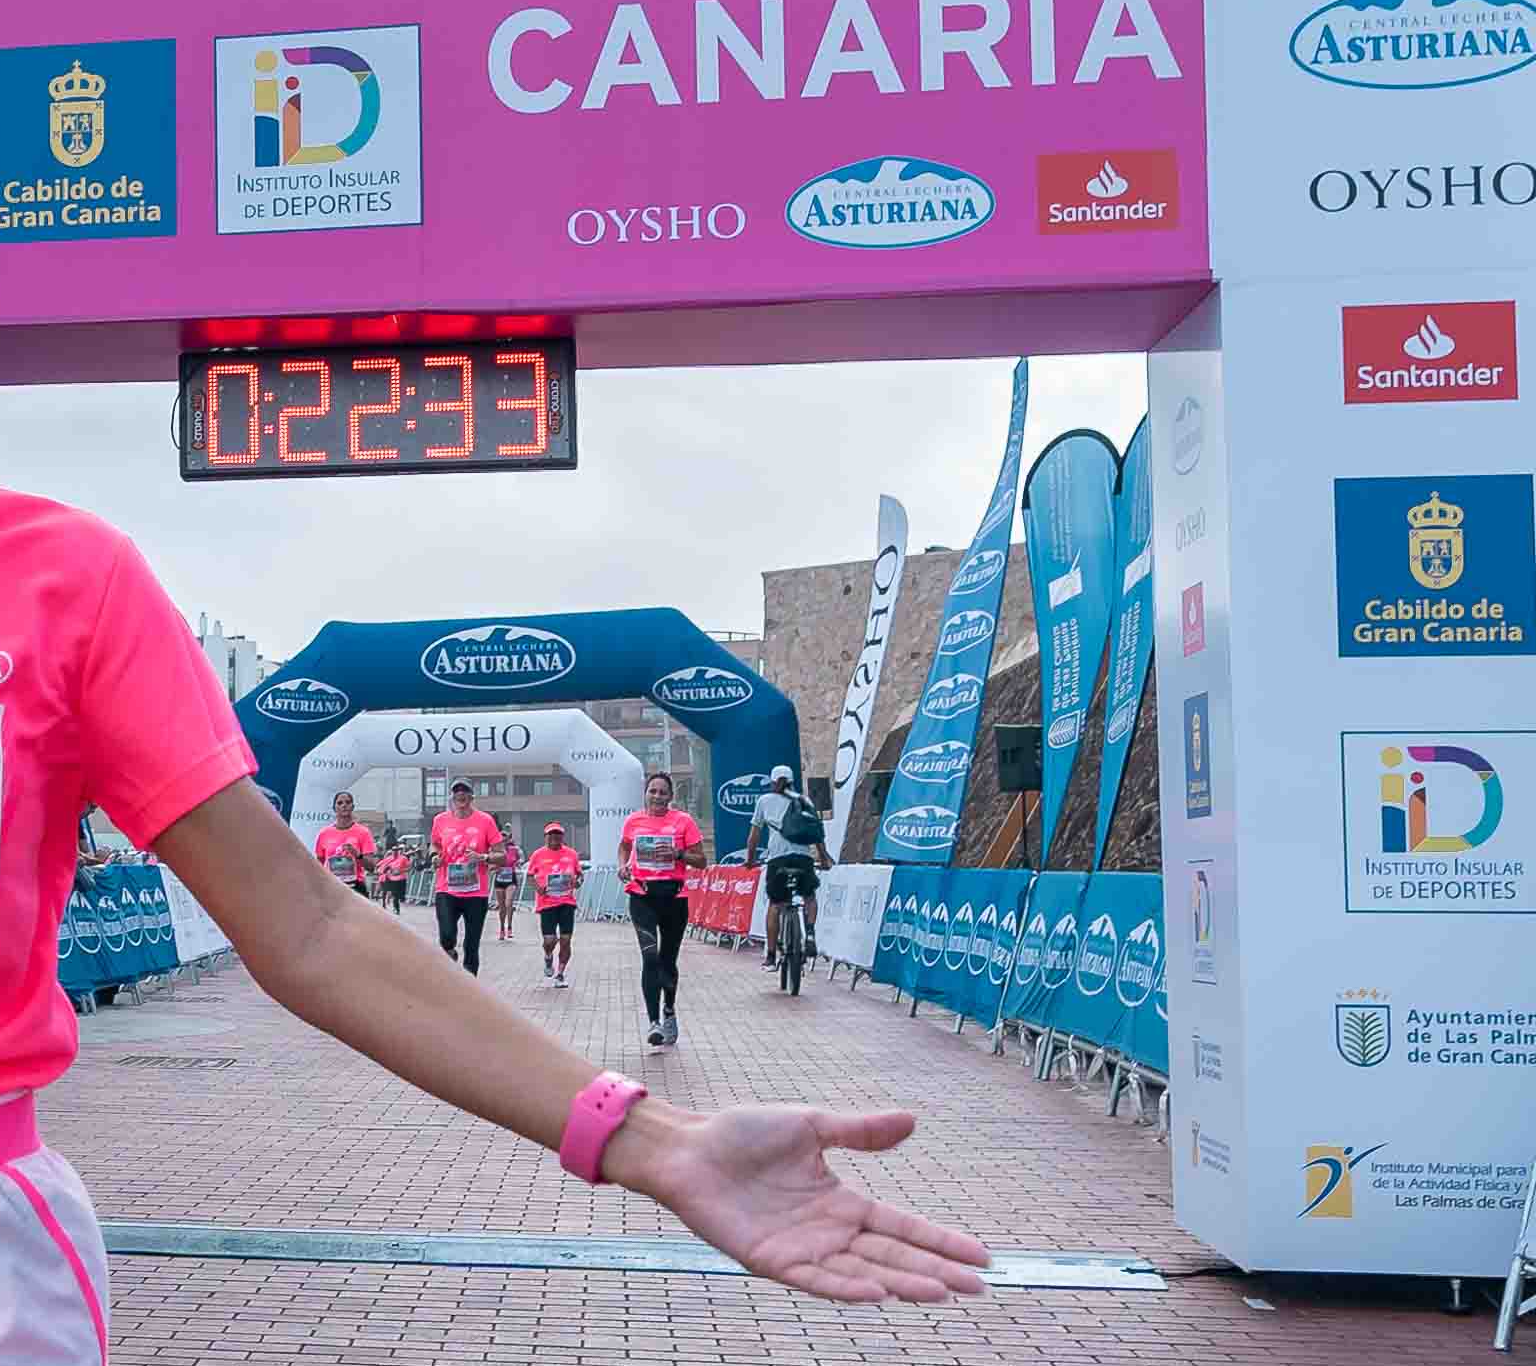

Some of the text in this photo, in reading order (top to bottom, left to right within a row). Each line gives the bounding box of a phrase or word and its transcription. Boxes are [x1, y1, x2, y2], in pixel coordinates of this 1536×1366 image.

[1310, 24, 1533, 65] ASTURIANA
[3, 176, 143, 203] Cabildo de
[237, 170, 400, 194] INSTITUTO INSULAR
[61, 200, 161, 226] Canaria
[244, 192, 392, 219] DE DEPORTES
[803, 193, 979, 230] ASTURIANA
[1048, 199, 1166, 224] Santander
[568, 203, 747, 245] OYSHO
[1357, 363, 1503, 391] Santander
[208, 352, 547, 465] 0:22:33
[1364, 598, 1504, 620] Cabildo de
[1353, 621, 1523, 643] Gran Canaria
[432, 647, 565, 675] ASTURIANA
[262, 692, 341, 712] ASTURIANA
[661, 684, 746, 700] ASTURIANA
[393, 723, 531, 756] OYSHO
[311, 756, 355, 770] OYSHO
[570, 749, 615, 762] OYSHO
[1365, 858, 1524, 876] INSTITUTO INSULAR
[1373, 881, 1516, 900] DE DEPORTES
[1407, 1030, 1432, 1044] de
[1446, 1030, 1478, 1044] Las
[1408, 1048, 1484, 1064] de Gran
[1371, 1162, 1527, 1178] Instituto Municipal para
[1372, 1179, 1389, 1188] de
[1394, 1179, 1405, 1188] la
[1408, 1179, 1470, 1191] Actividad
[1514, 1182, 1524, 1194] y
[1395, 1194, 1418, 1207] Las
[1422, 1195, 1473, 1209] Palmas
[1477, 1196, 1495, 1209] de
